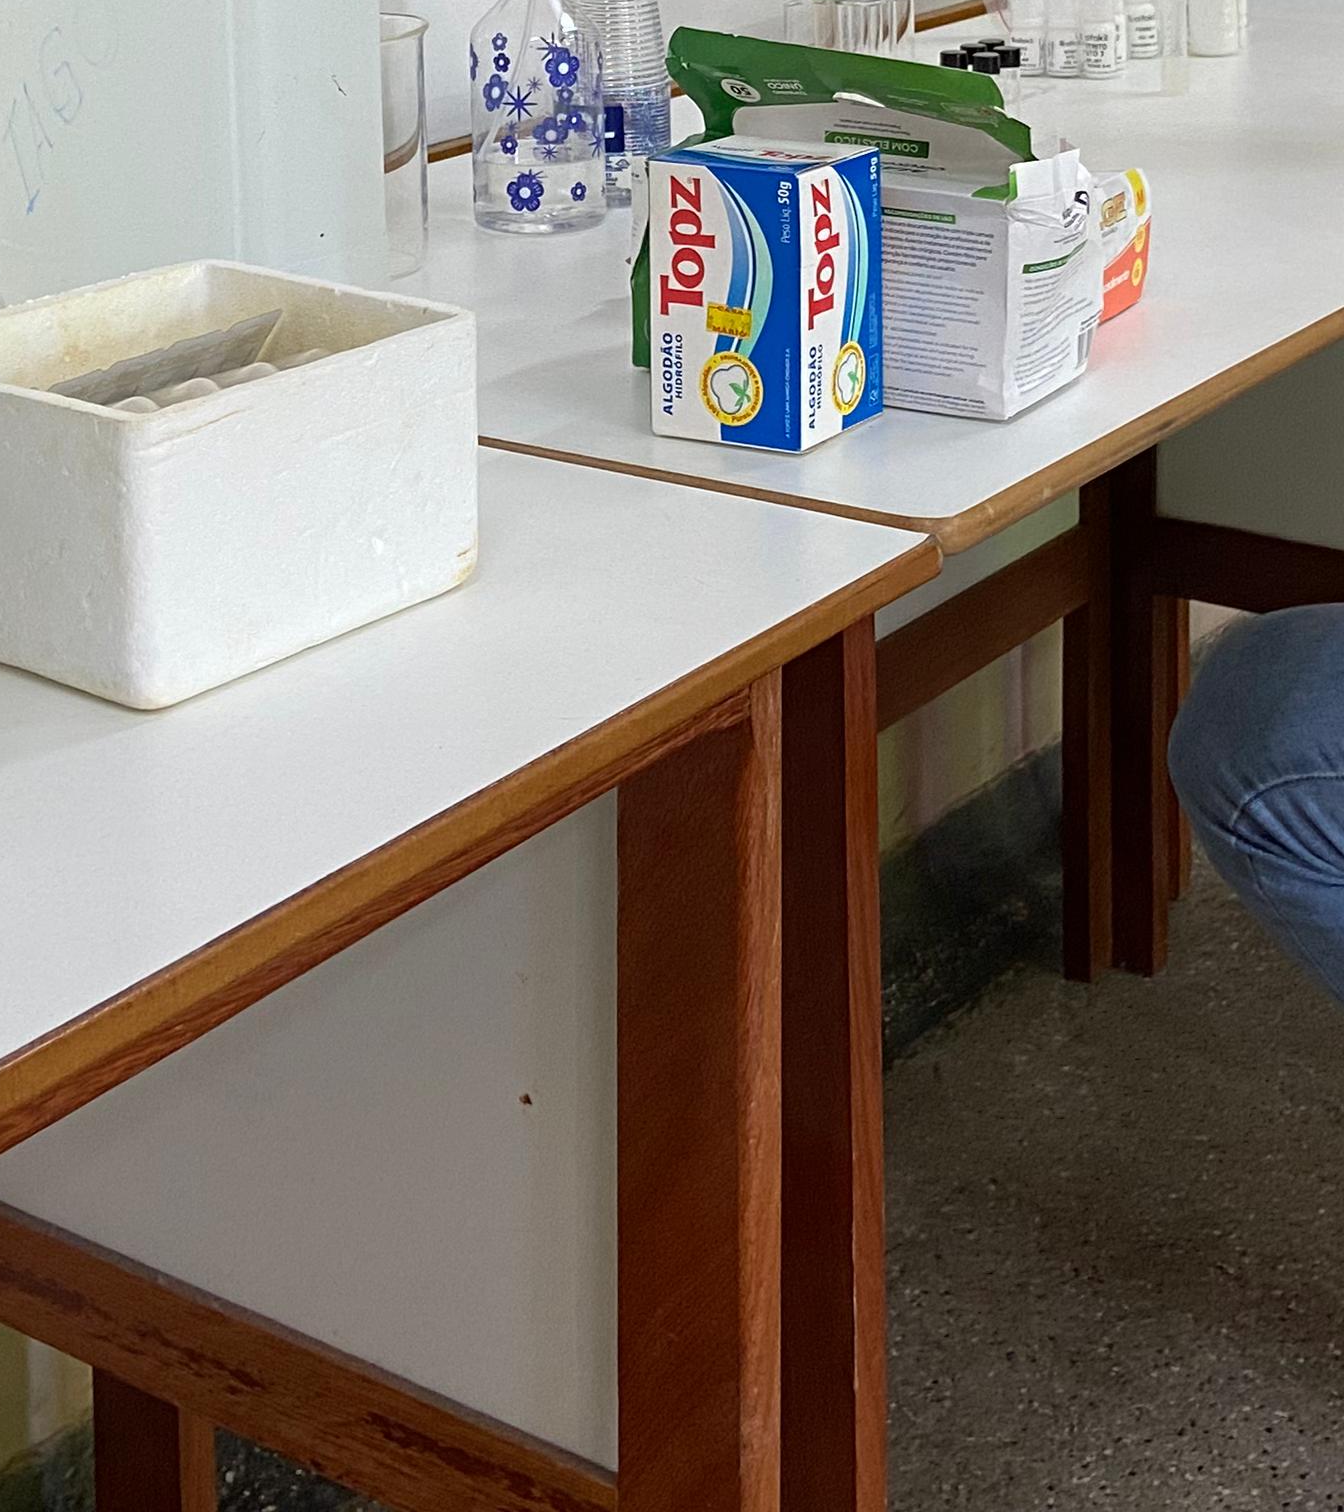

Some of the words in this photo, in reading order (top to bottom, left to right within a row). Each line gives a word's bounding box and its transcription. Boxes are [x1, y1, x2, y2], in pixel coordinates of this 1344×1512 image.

[870, 157, 878, 180] 50g
[891, 142, 919, 154] COM
[777, 180, 793, 205] 50g
[659, 175, 716, 316] Topz
[780, 224, 791, 244] Peso
[808, 178, 840, 331] Topz
[660, 332, 674, 416] ALGODÃO
[674, 333, 683, 399] HIDRÓFILO
[808, 346, 817, 430] ALGODÃO
